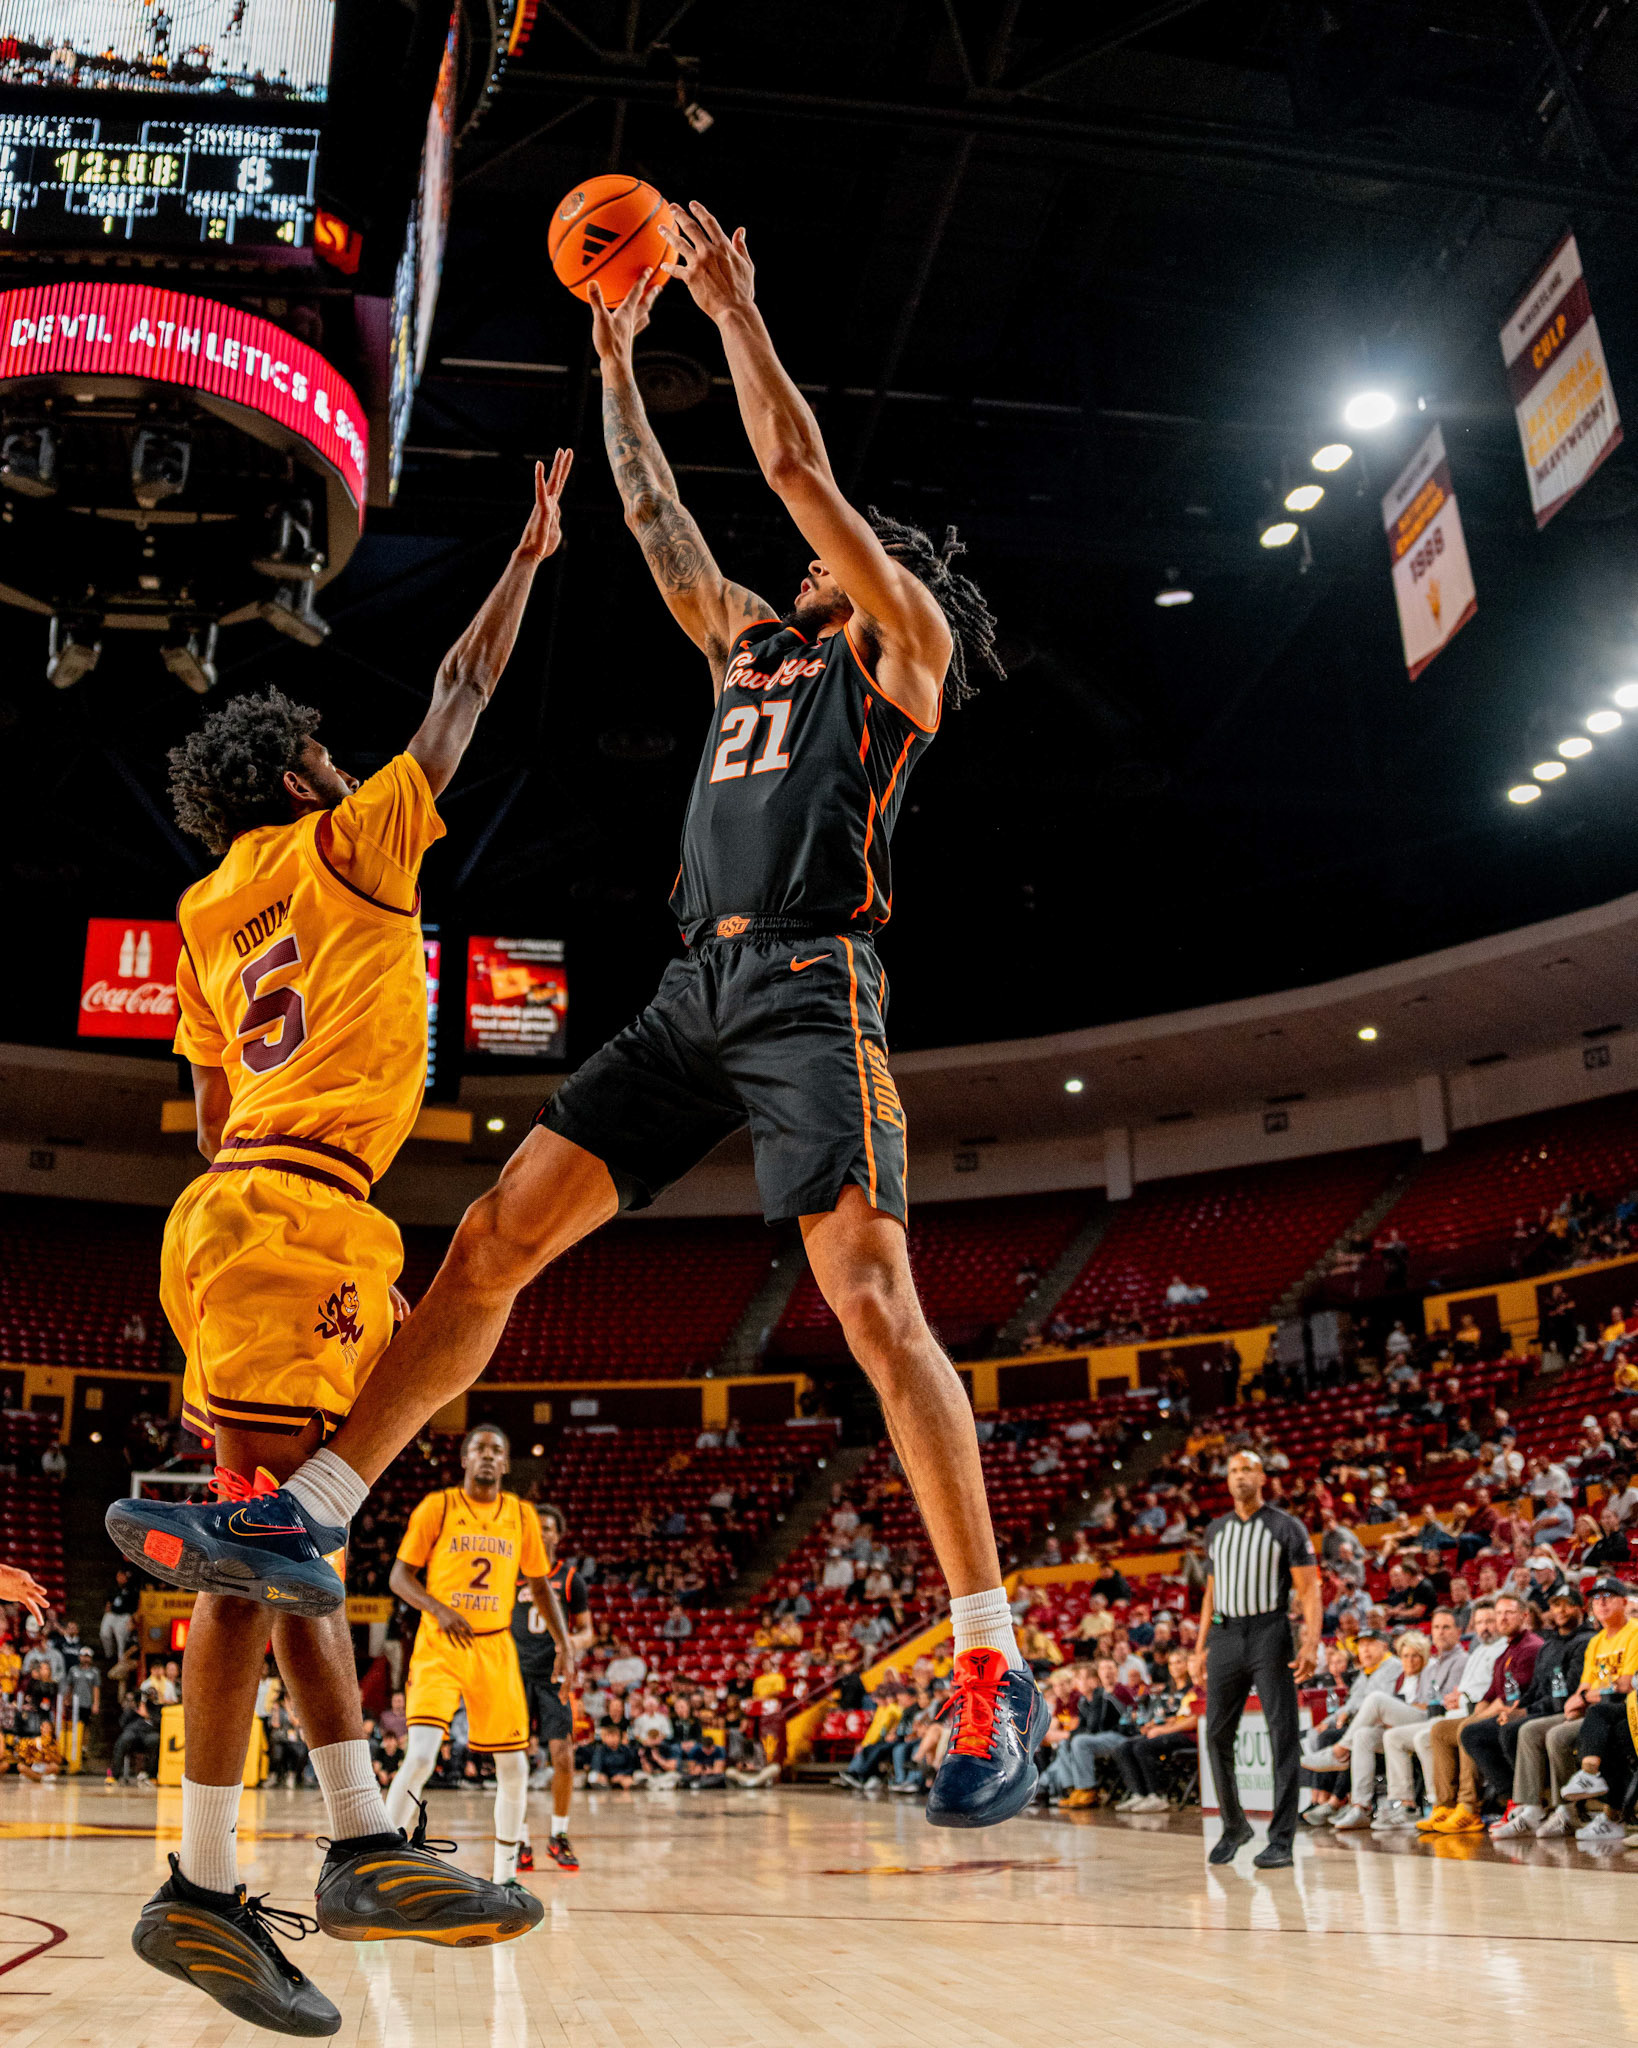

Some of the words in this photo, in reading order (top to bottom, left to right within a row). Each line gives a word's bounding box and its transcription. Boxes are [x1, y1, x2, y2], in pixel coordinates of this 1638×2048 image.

[10, 313, 113, 348] DEVIL
[129, 317, 308, 403] ATHLETICS
[1532, 313, 1567, 370] CULP
[709, 699, 793, 785] 21
[717, 915, 751, 939] OSU
[236, 933, 308, 1077] 5
[448, 1535, 514, 1560] ARIZONA
[468, 1557, 493, 1591] 2
[450, 1592, 500, 1613] STATE
